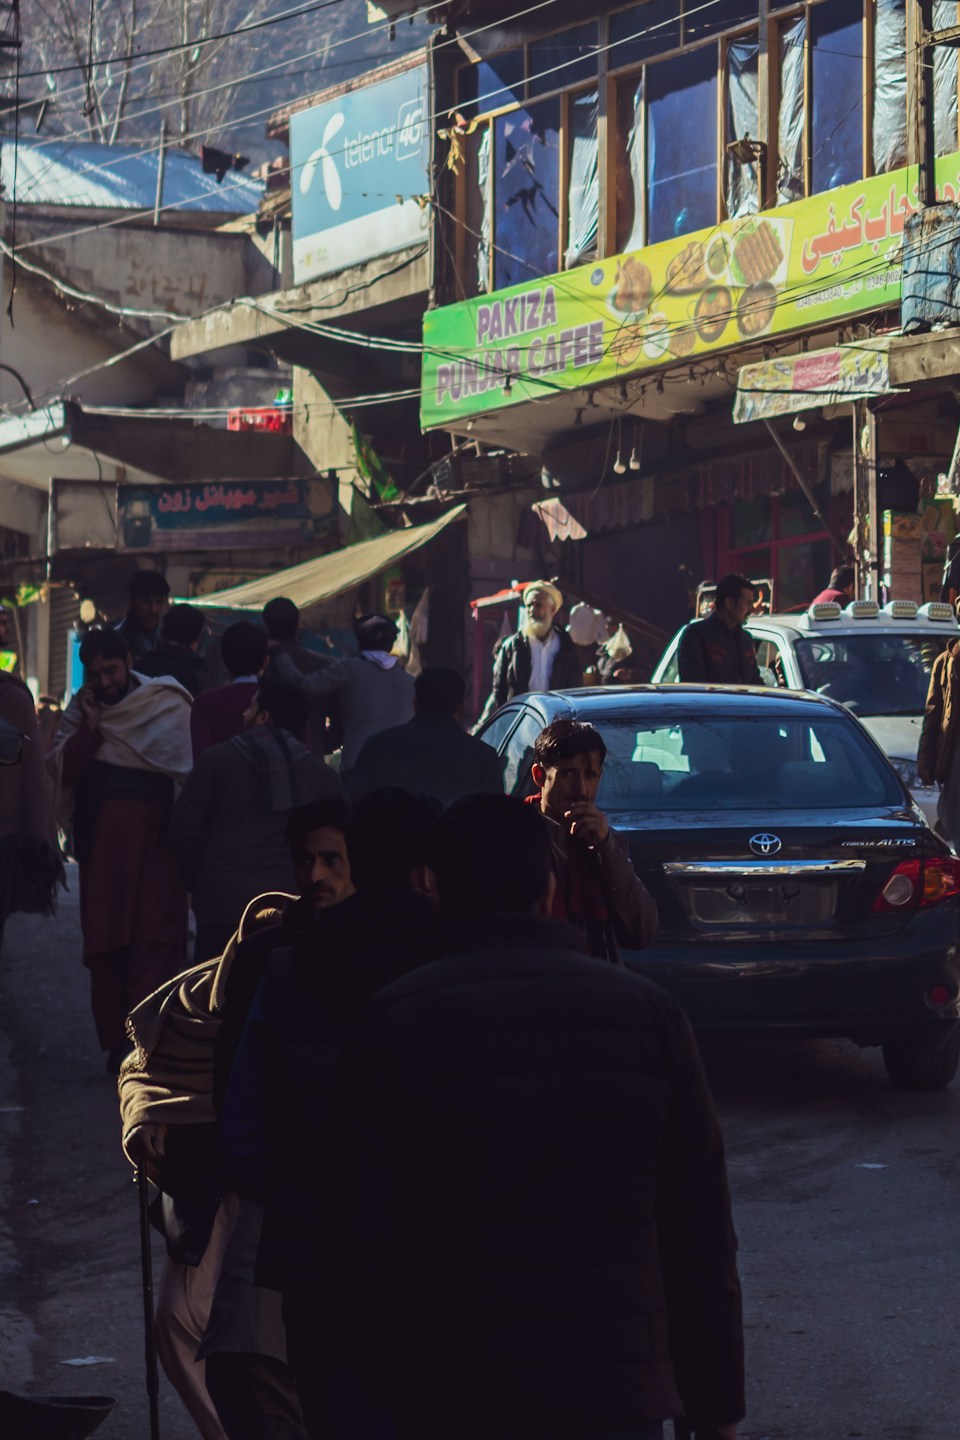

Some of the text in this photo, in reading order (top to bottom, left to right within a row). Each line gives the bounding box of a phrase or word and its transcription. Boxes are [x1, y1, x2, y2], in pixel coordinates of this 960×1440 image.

[343, 107, 423, 169] telenor 4G
[802, 193, 866, 274] کیفی
[476, 285, 558, 346] PAKIZA
[435, 320, 605, 406] PUNJAB CAFEE
[876, 838, 916, 847] ALTIS
